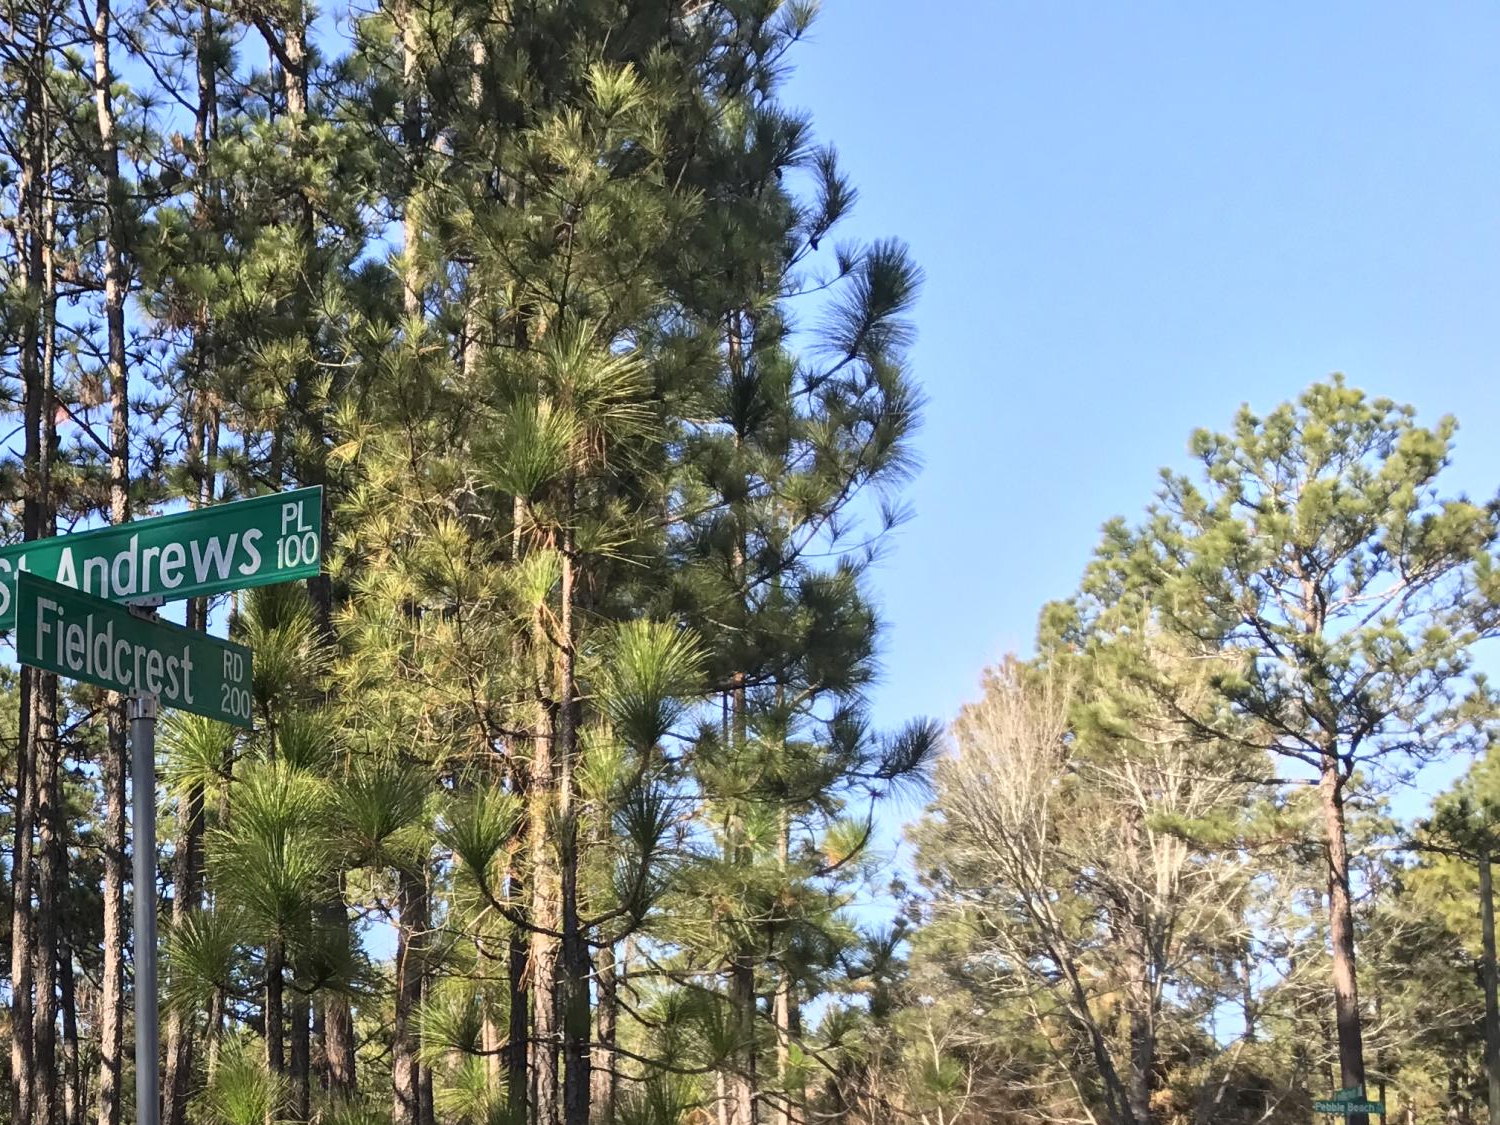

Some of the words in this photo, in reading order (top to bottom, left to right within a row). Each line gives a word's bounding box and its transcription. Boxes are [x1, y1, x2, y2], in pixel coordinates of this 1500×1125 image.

[281, 501, 313, 536] PL
[55, 528, 264, 600] Andrews
[276, 531, 319, 570] 100
[36, 596, 194, 704] Fieldcrest
[223, 649, 244, 683] RD
[221, 683, 251, 720] 200
[1315, 1102, 1345, 1112] Pebble
[1347, 1102, 1375, 1113] Beach
